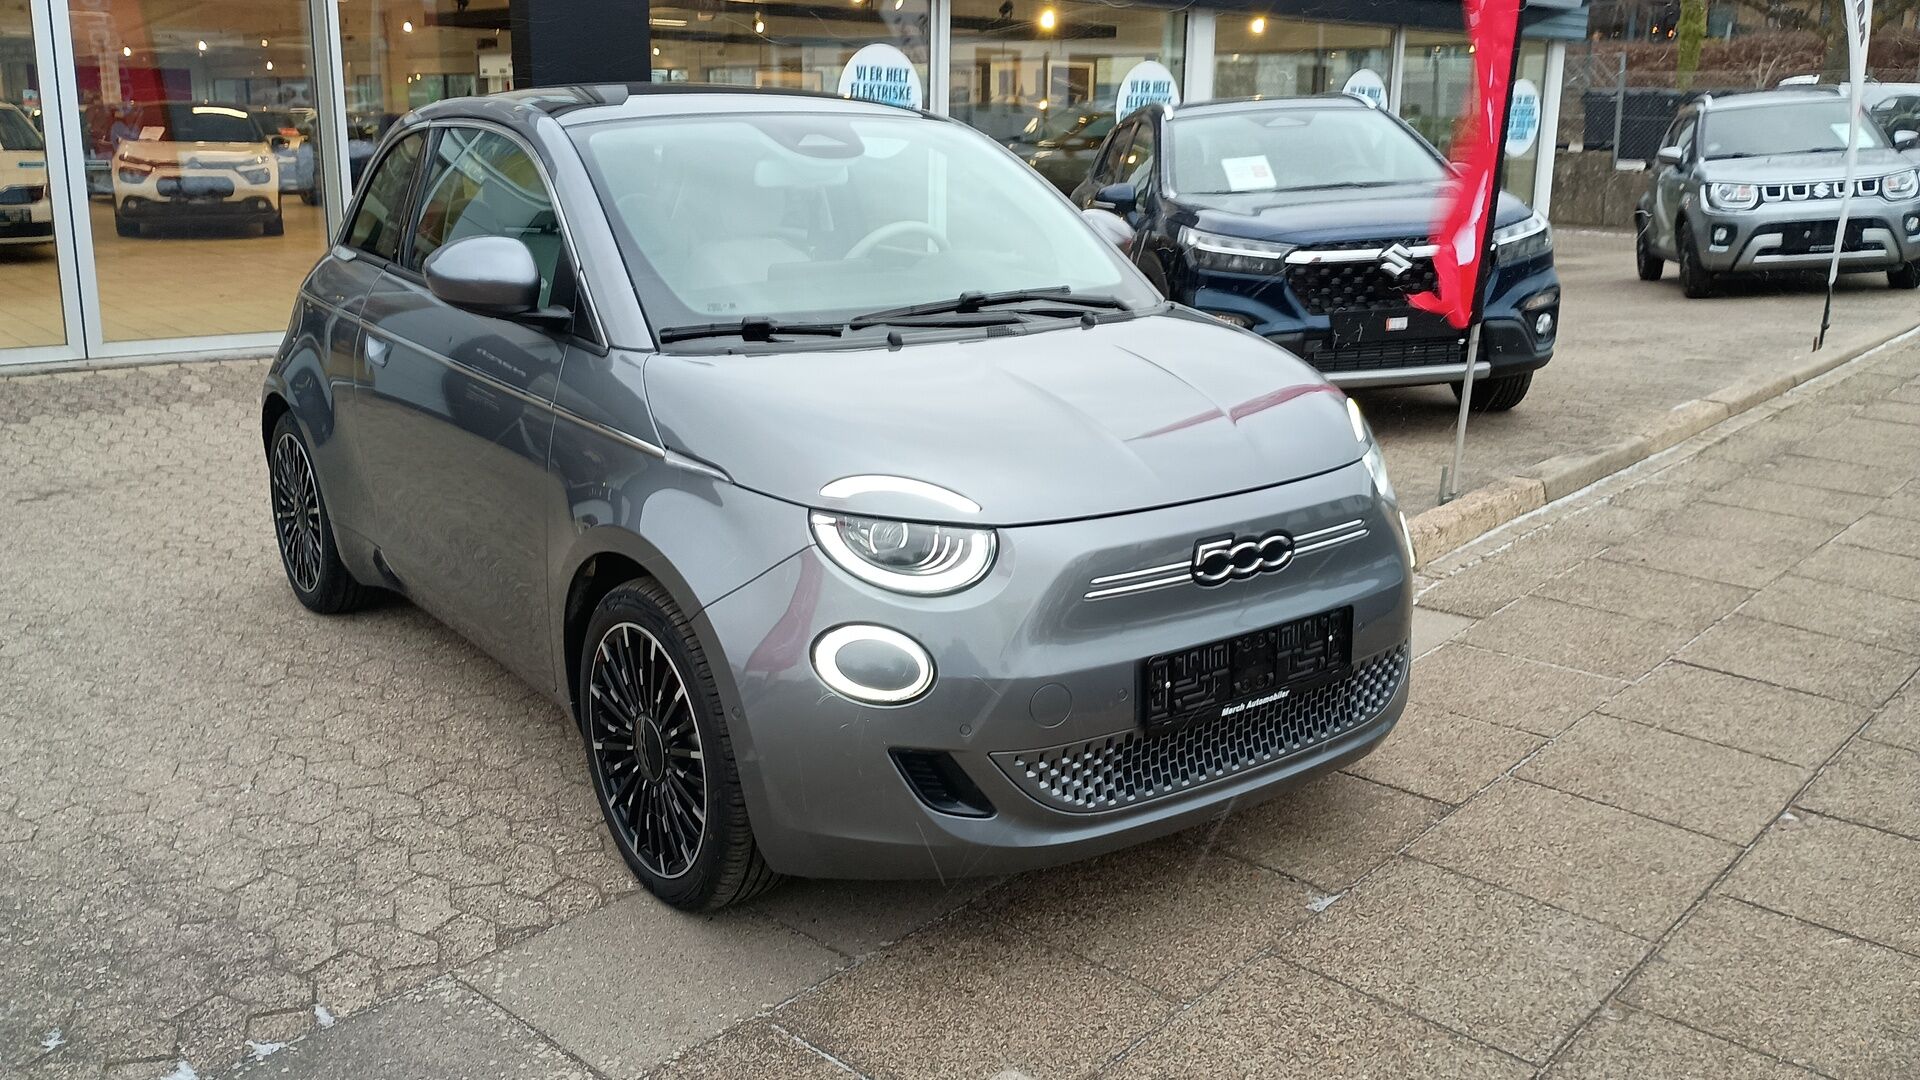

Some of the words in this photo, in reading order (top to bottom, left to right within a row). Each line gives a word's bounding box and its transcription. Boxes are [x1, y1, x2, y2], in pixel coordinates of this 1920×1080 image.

[856, 64, 867, 81] VI
[870, 66, 882, 81] ER
[886, 67, 910, 83] HELT
[1191, 529, 1295, 588] 500
[1246, 690, 1290, 709] Automobiler
